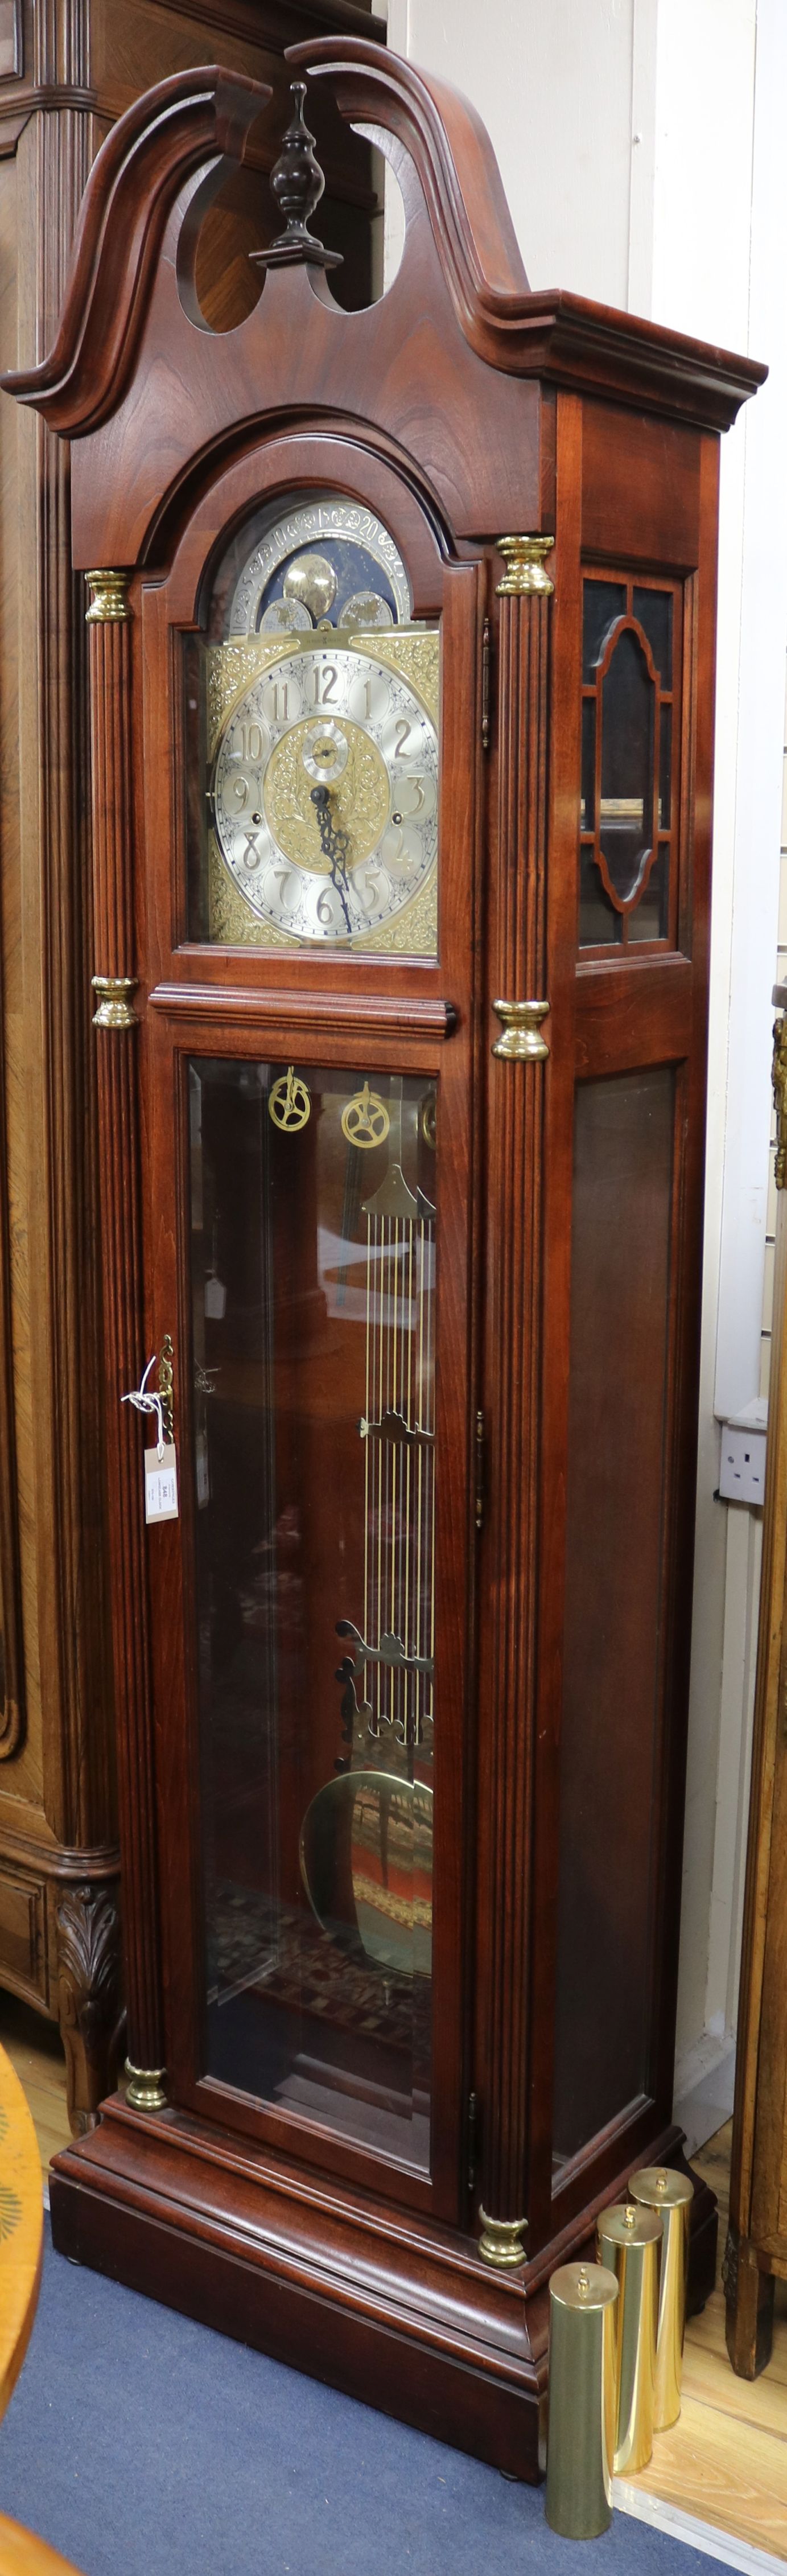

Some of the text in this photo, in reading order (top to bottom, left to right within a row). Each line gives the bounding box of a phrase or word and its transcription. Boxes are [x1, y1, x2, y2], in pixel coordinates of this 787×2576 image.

[359, 516, 378, 541] 20
[271, 681, 290, 721] 11
[313, 665, 338, 705] 12
[364, 678, 372, 719] 1
[241, 722, 263, 762] 10
[395, 718, 411, 759] 2
[233, 776, 249, 815] 9
[406, 775, 425, 814] 3
[243, 832, 261, 870] 8
[396, 829, 413, 871] 4
[273, 871, 292, 911] 7
[316, 886, 335, 925] 6
[362, 871, 381, 912] 5
